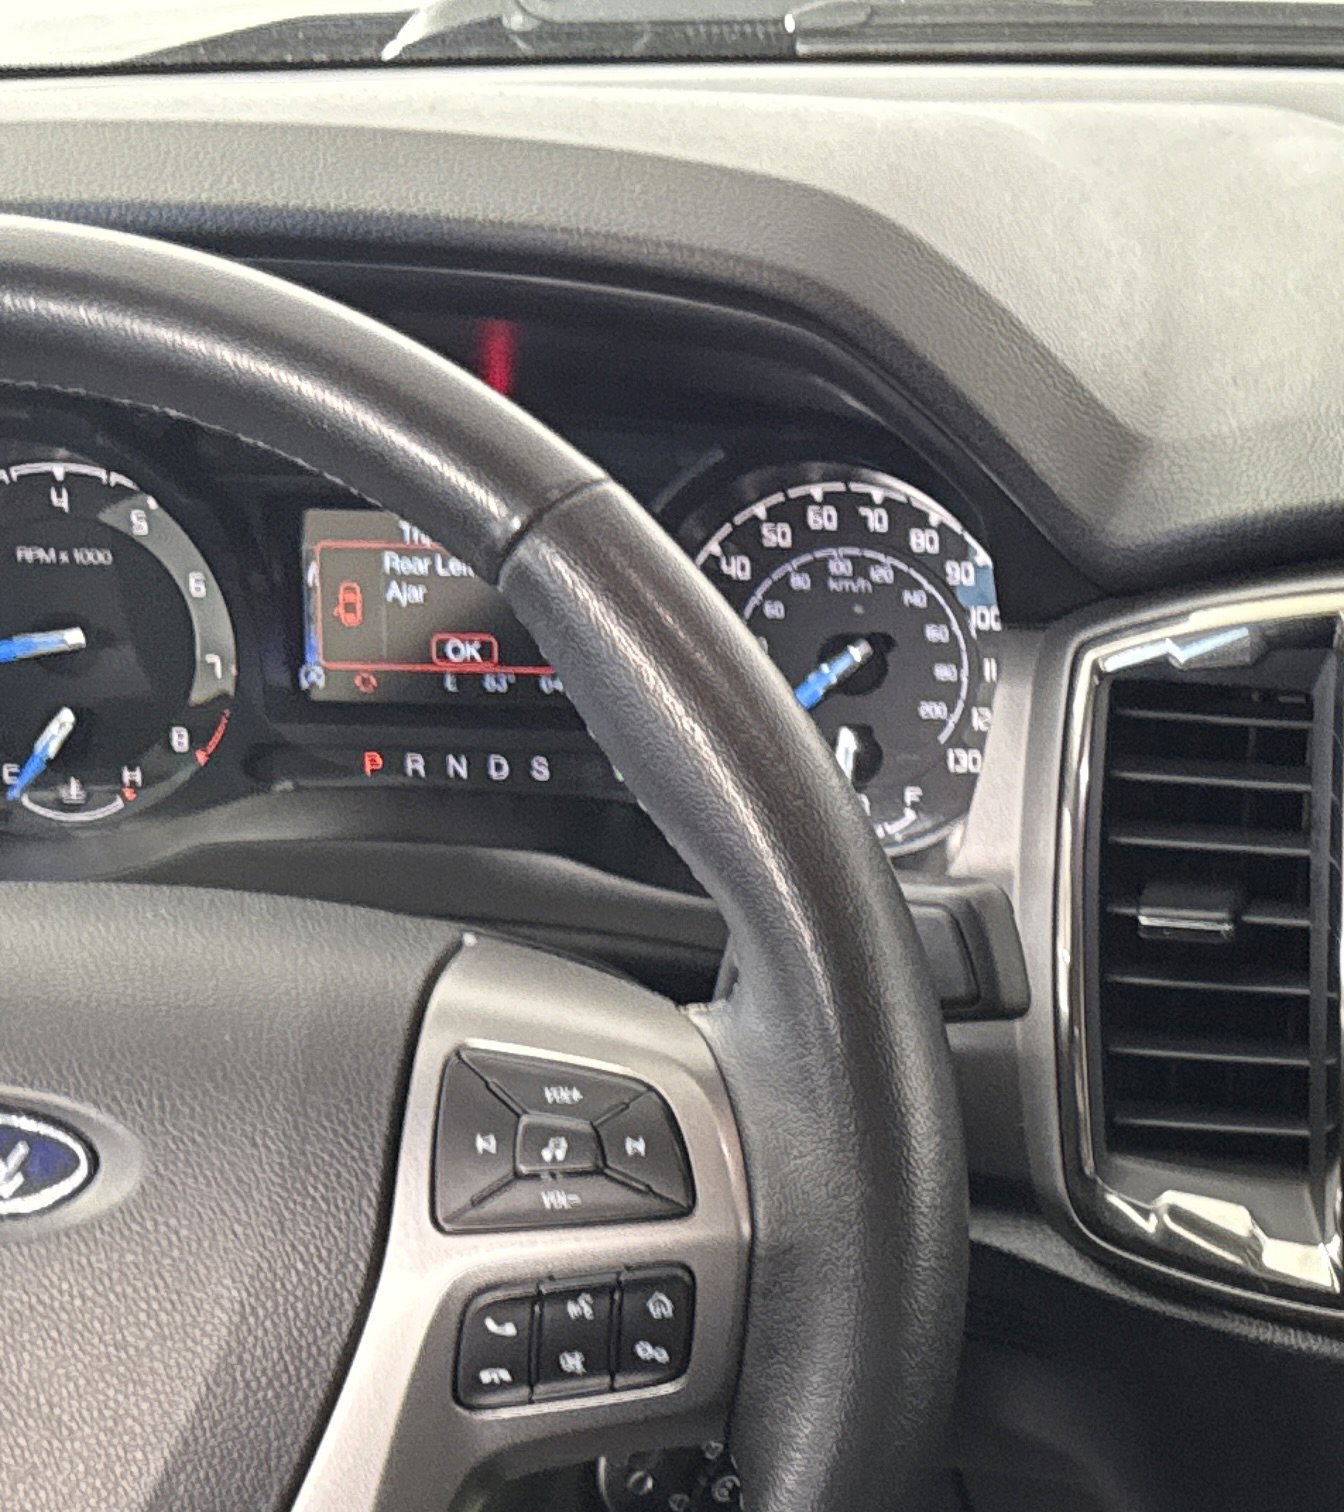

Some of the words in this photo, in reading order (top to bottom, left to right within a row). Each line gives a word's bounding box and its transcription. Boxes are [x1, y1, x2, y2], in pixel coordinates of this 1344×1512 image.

[51, 487, 70, 513] 4
[807, 504, 838, 531] 60
[858, 506, 889, 533] 70
[760, 522, 792, 548] 50
[909, 529, 940, 554] 80
[16, 546, 56, 565] RPM
[73, 547, 114, 565] 1000
[383, 551, 432, 577] Rear
[719, 554, 752, 581] 40
[188, 571, 207, 598] 6
[828, 575, 873, 594] km/h
[945, 560, 976, 586] 90
[385, 580, 428, 607] Ajar
[445, 638, 483, 662] OK
[971, 706, 993, 731] 12
[122, 766, 142, 788] H
[363, 752, 384, 776] P
[405, 754, 427, 778] R
[446, 754, 469, 779] N
[488, 754, 510, 780] D
[530, 756, 551, 781] S
